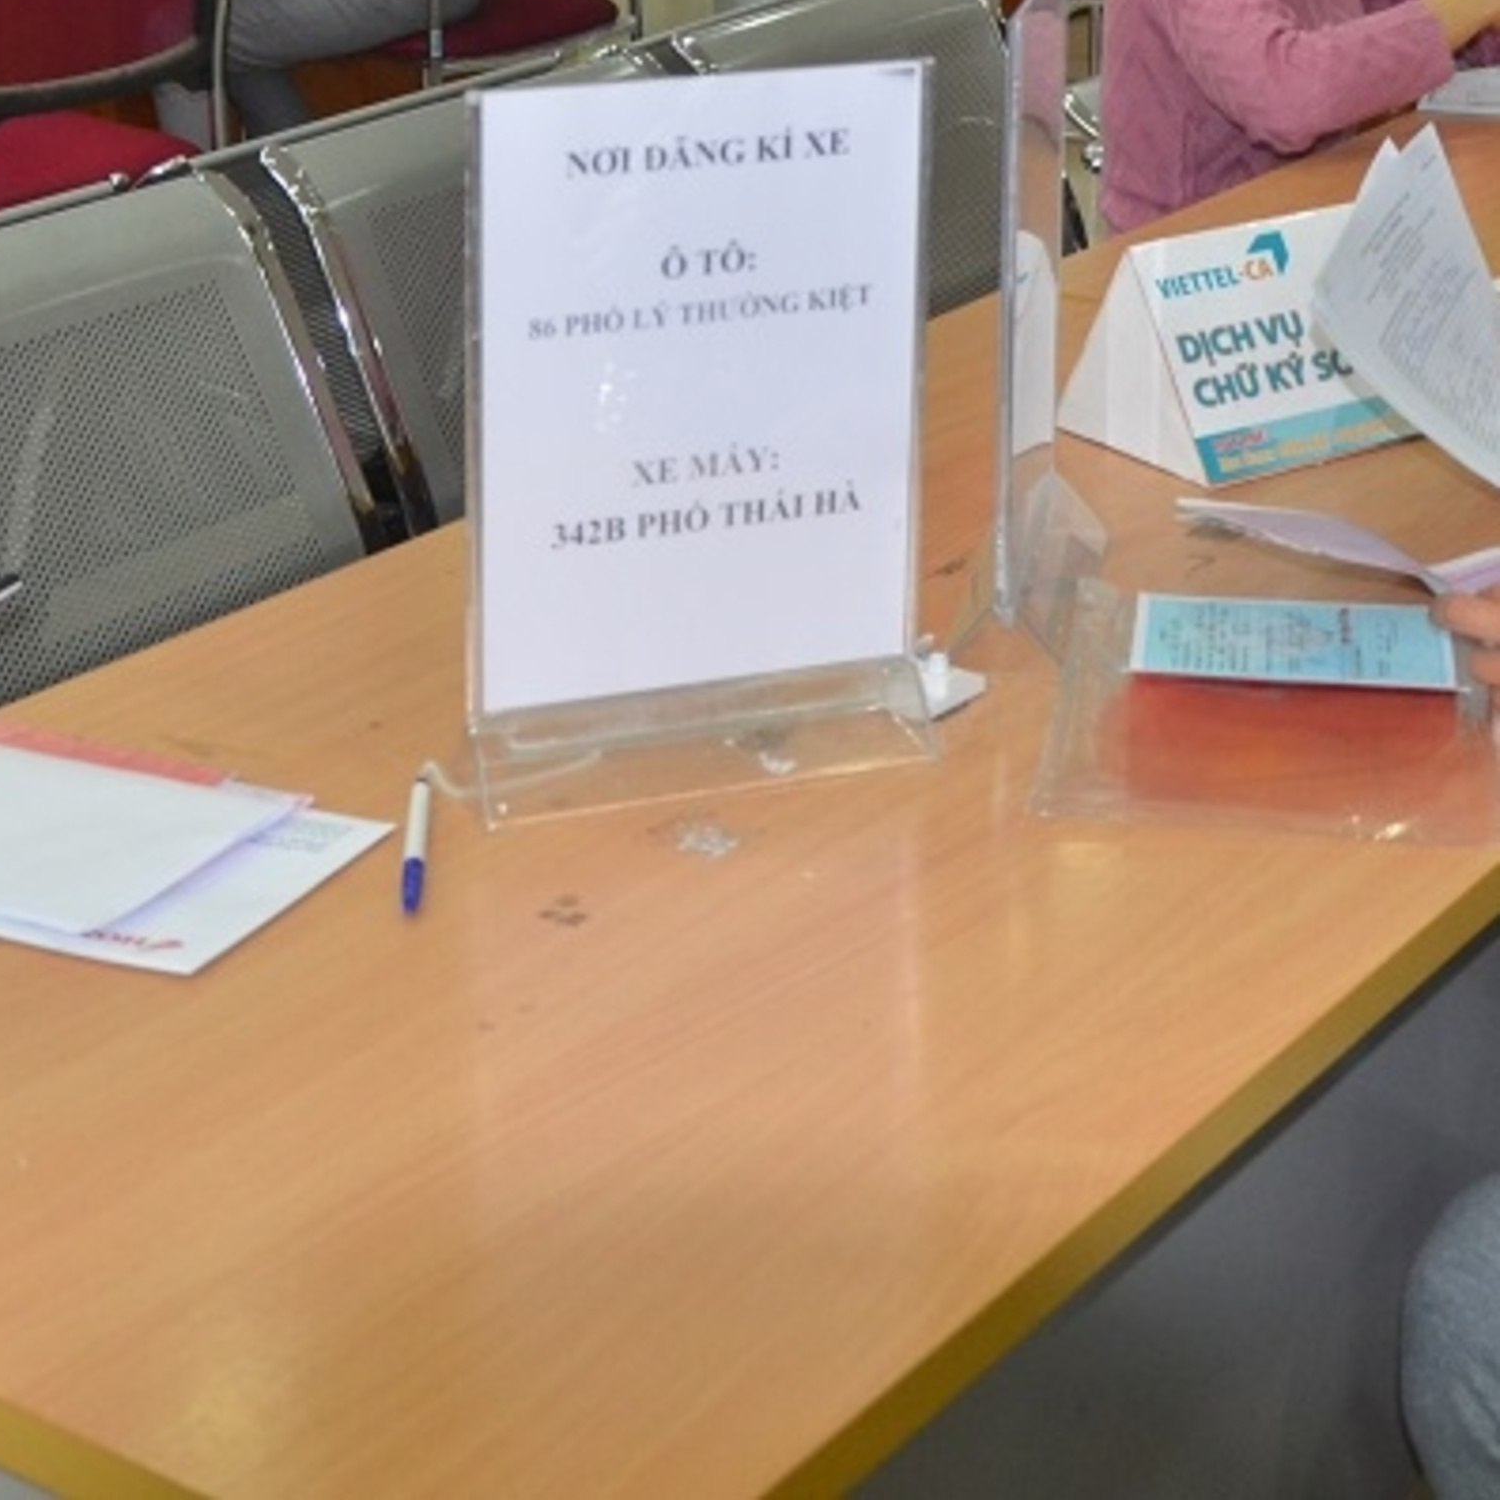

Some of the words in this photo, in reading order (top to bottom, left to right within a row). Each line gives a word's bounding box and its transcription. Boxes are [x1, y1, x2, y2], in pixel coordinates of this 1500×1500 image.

[566, 146, 633, 180] NƠI
[756, 127, 794, 163] KÍ
[803, 127, 851, 159] XE
[660, 245, 688, 280] Ô
[699, 239, 757, 276] TÔ:
[528, 316, 559, 341] 86
[632, 300, 672, 330] LÝ
[680, 290, 800, 327] THƯỜNG
[807, 283, 874, 313] KIỆT
[1175, 320, 1257, 367] DỊCH
[1254, 309, 1304, 349] VỤ
[1193, 362, 1261, 408] CHỮ
[631, 455, 679, 488] XE
[688, 443, 781, 482] MÁY:
[551, 516, 627, 551] 342B
[718, 489, 804, 529] THÁI
[815, 482, 863, 514] HÀ
